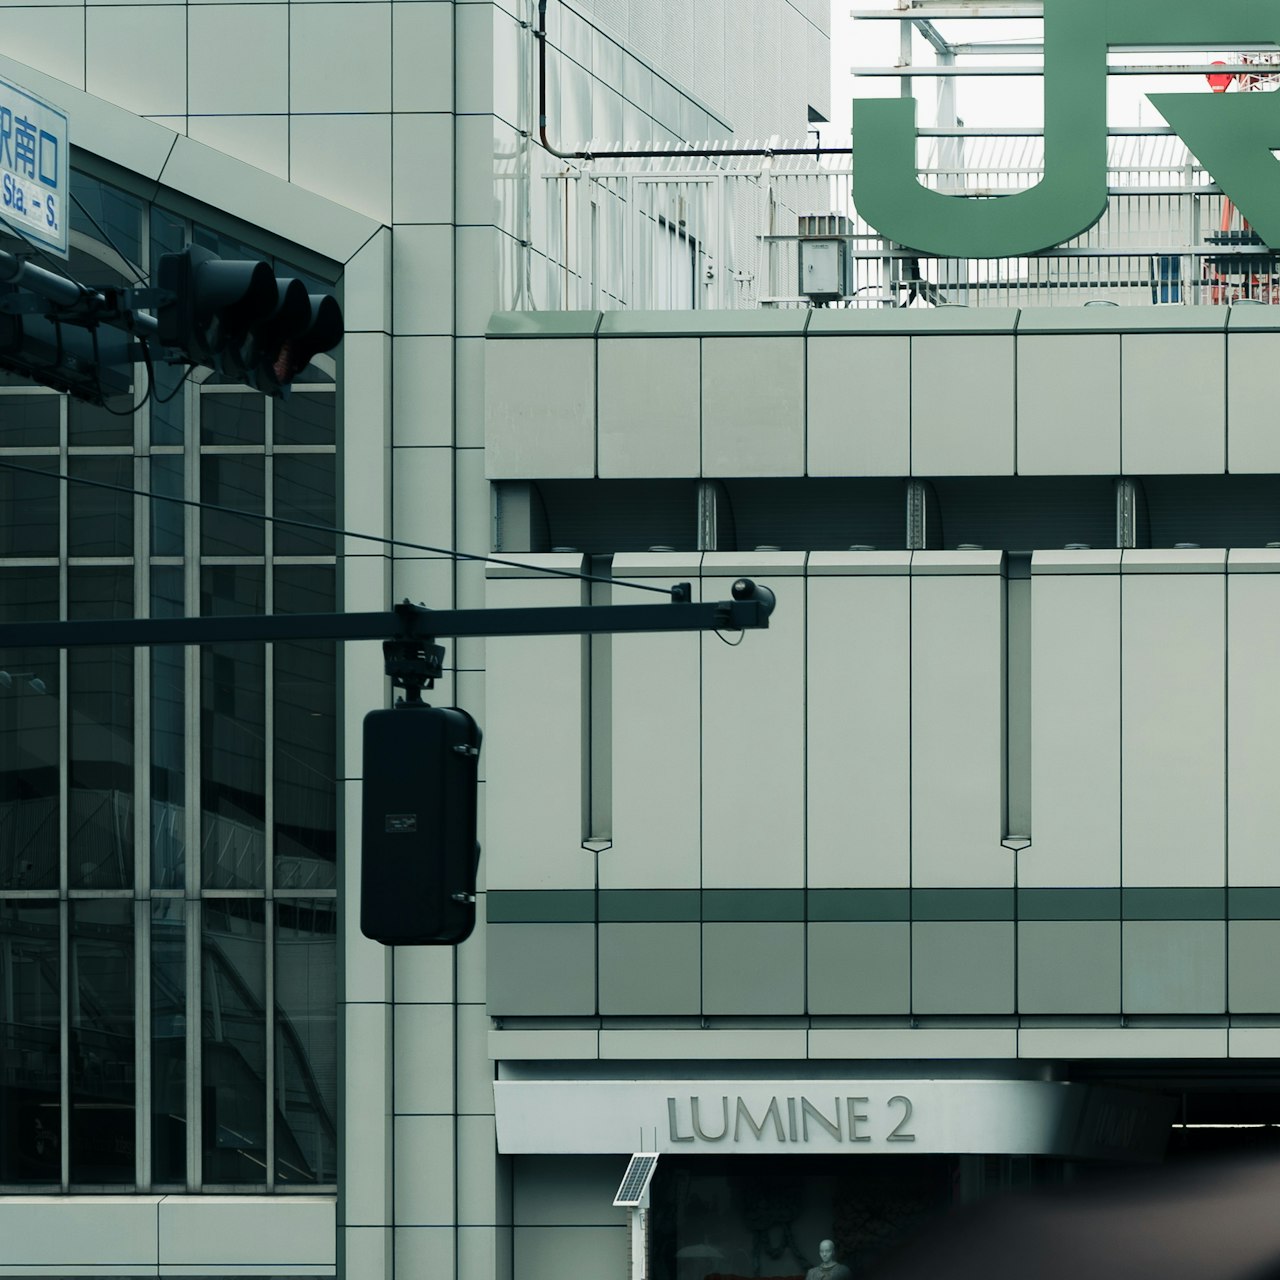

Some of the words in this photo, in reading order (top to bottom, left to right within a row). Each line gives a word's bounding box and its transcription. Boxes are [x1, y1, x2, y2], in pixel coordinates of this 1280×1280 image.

[46, 194, 58, 230] S.
[667, 1096, 871, 1143] LUMINE
[886, 1095, 916, 1142] 2
